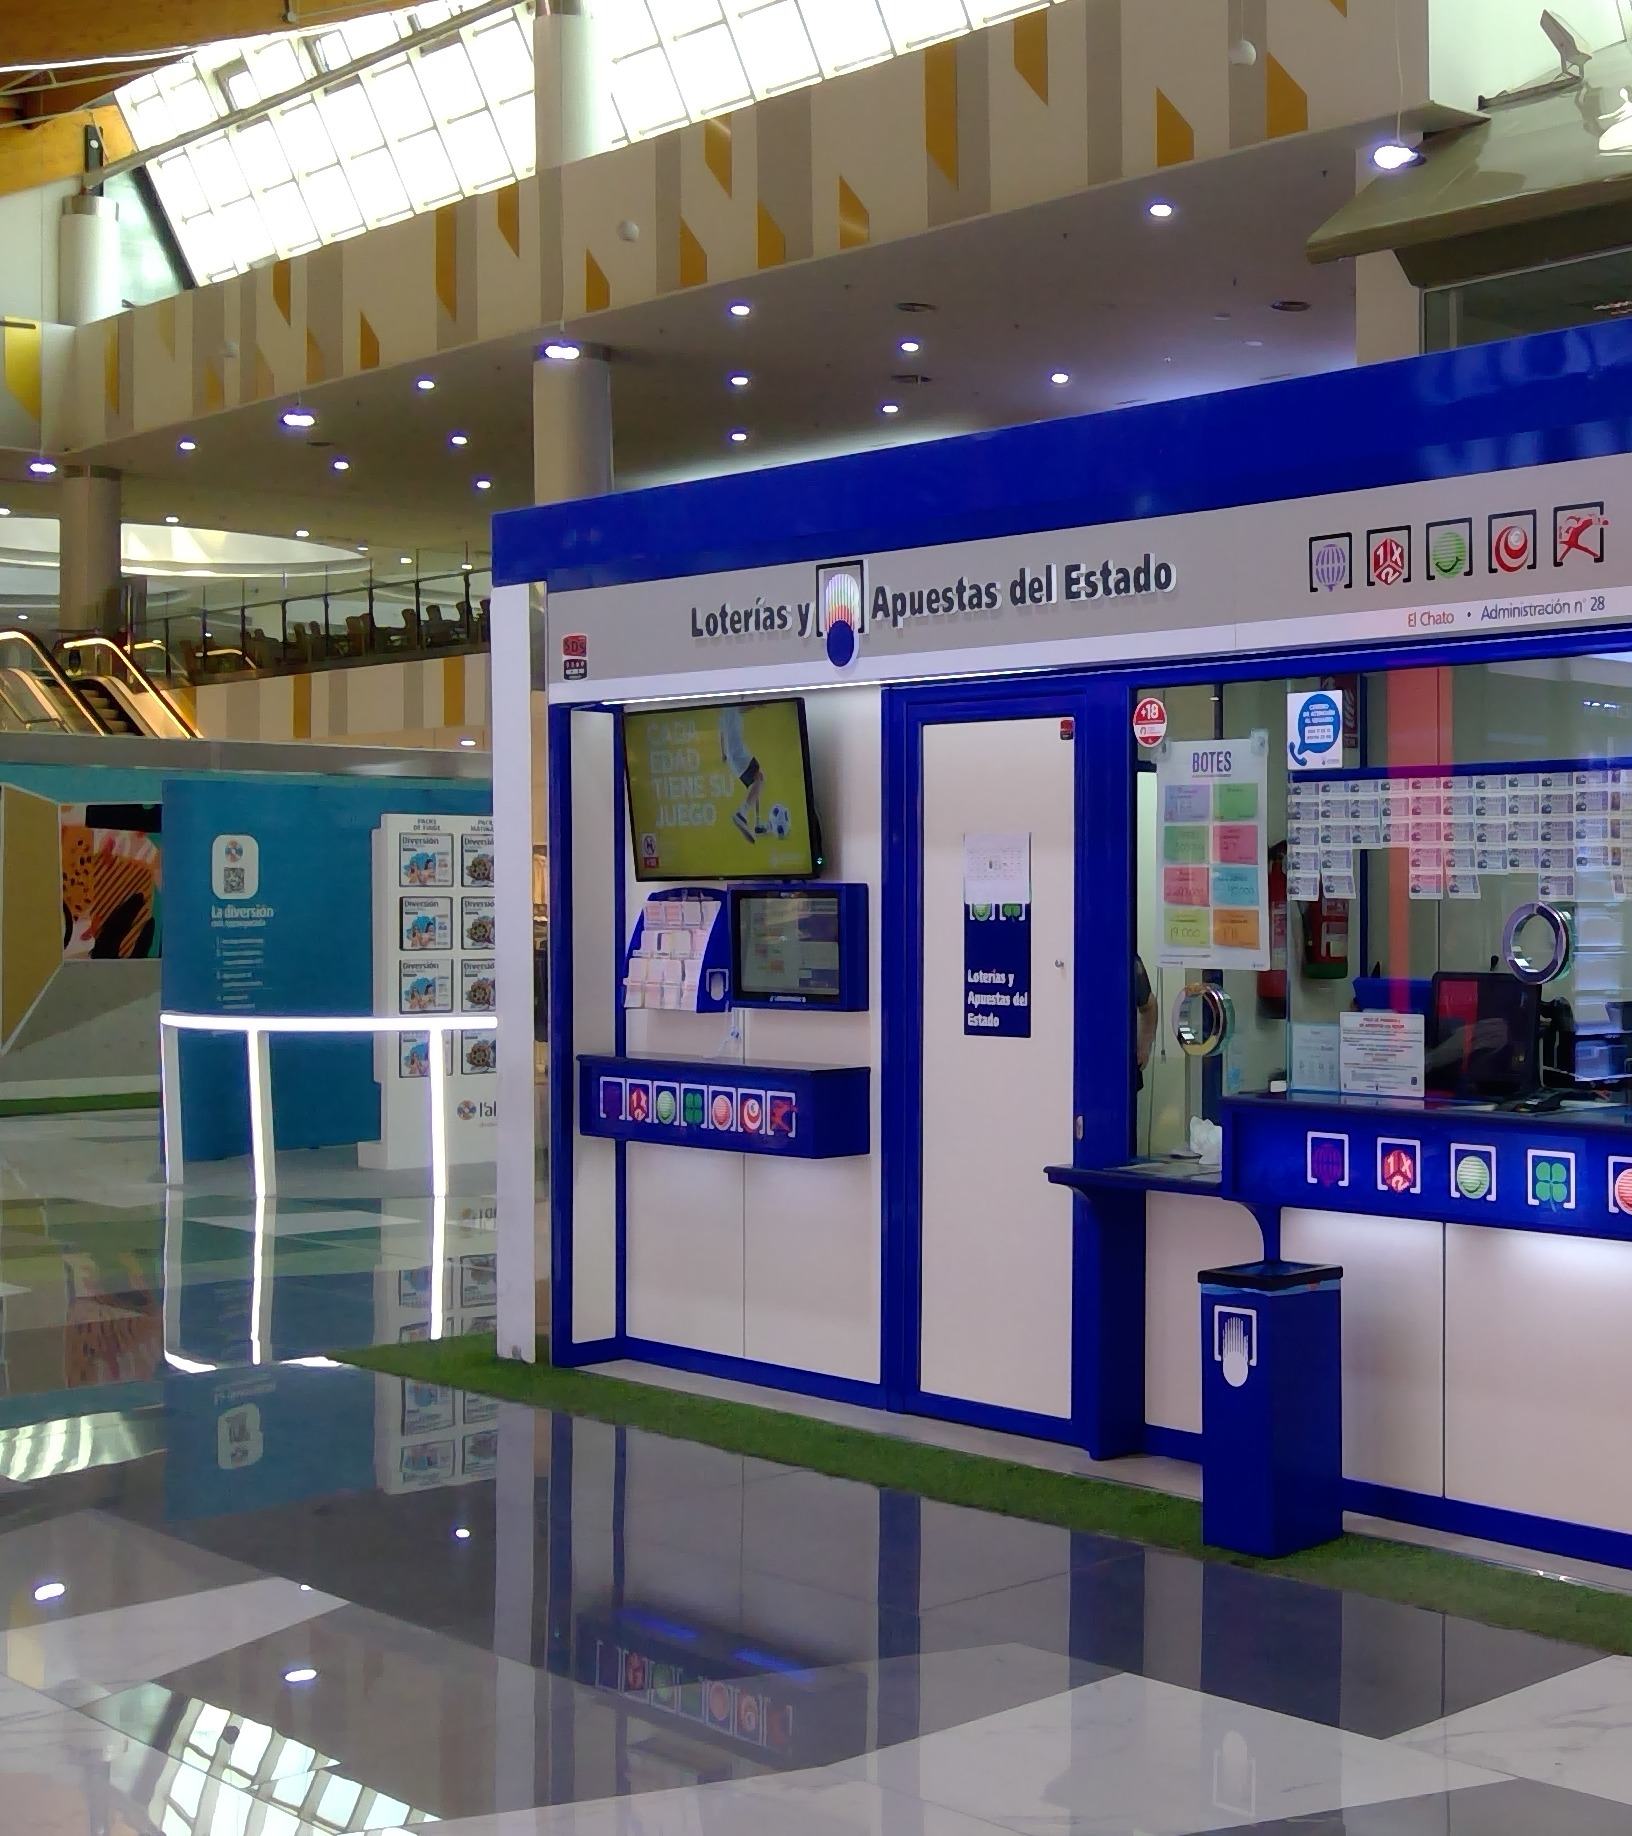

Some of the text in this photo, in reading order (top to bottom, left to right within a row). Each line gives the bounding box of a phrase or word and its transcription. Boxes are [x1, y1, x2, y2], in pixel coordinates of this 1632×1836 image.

[871, 553, 1175, 628] Apuestas del Estado
[691, 597, 815, 638] Loterías y
[1407, 611, 1417, 627] El
[1419, 609, 1455, 626] Chato
[1480, 599, 1571, 622] Administración
[1589, 596, 1606, 612] 28
[1140, 703, 1160, 720] +18
[1192, 750, 1232, 773] BOTES
[651, 774, 705, 800] TIENE
[655, 803, 717, 828] JUEGO
[402, 836, 440, 845] Diversión
[967, 969, 1015, 987] Loterías y
[967, 990, 1028, 1008] Apuestas del
[967, 1012, 1000, 1028] Estado
